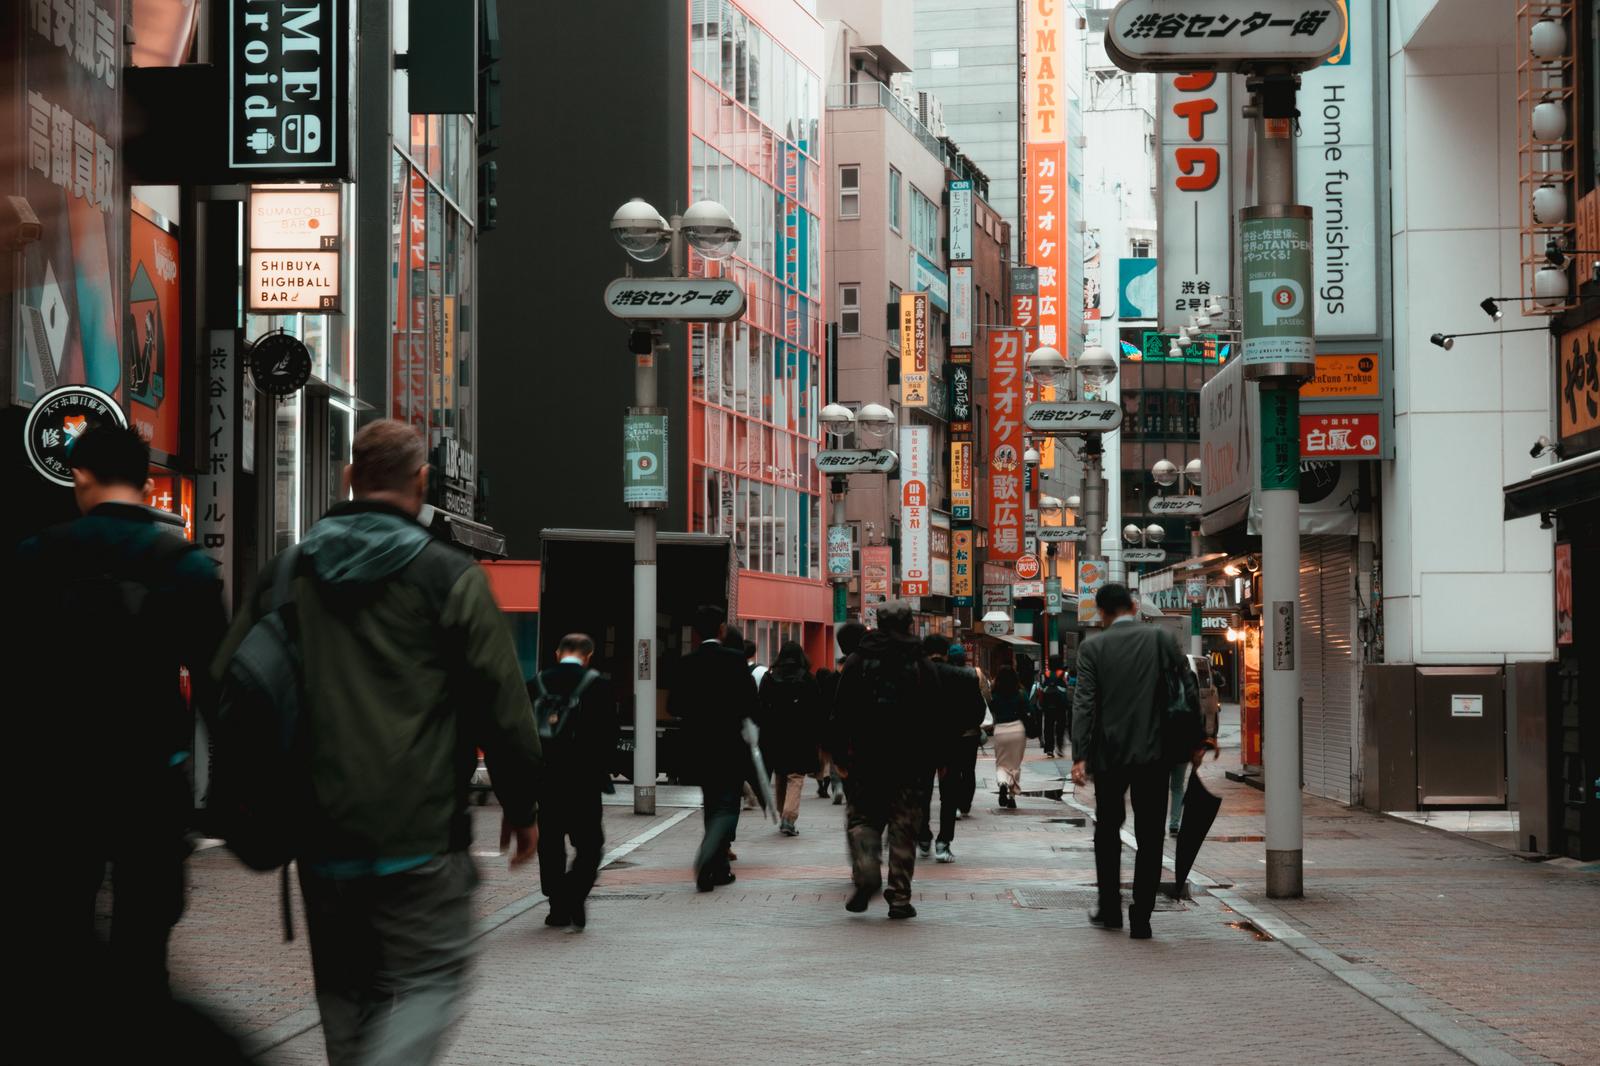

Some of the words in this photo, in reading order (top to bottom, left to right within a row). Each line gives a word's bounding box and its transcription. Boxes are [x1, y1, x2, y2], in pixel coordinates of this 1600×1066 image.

[1123, 10, 1331, 38] 渋谷センター街
[245, 0, 277, 120] roid
[1323, 85, 1345, 160] Home
[28, 90, 114, 215] 高額買取
[952, 191, 960, 250] モニタールーム
[324, 238, 335, 247] 1F
[1037, 158, 1056, 346] カラオケ歌広場
[1320, 170, 1349, 315] furnishings
[261, 261, 320, 271] SHIBUYA
[261, 277, 330, 287] HIGHBALL
[1182, 281, 1210, 294] 渋谷
[261, 292, 288, 301] BAR
[612, 290, 734, 305] 渋谷センター街
[915, 298, 925, 369] 全身もみほぐし
[993, 331, 1018, 440] カラオケ
[1029, 409, 1117, 421] 渋谷センター街
[819, 455, 889, 465] 渋谷センター街
[955, 507, 968, 517] 2F
[993, 475, 1019, 553] 歌広場
[1152, 501, 1201, 510] 渋谷センター
[956, 549, 968, 575] 松屋
[908, 584, 923, 594] B1
